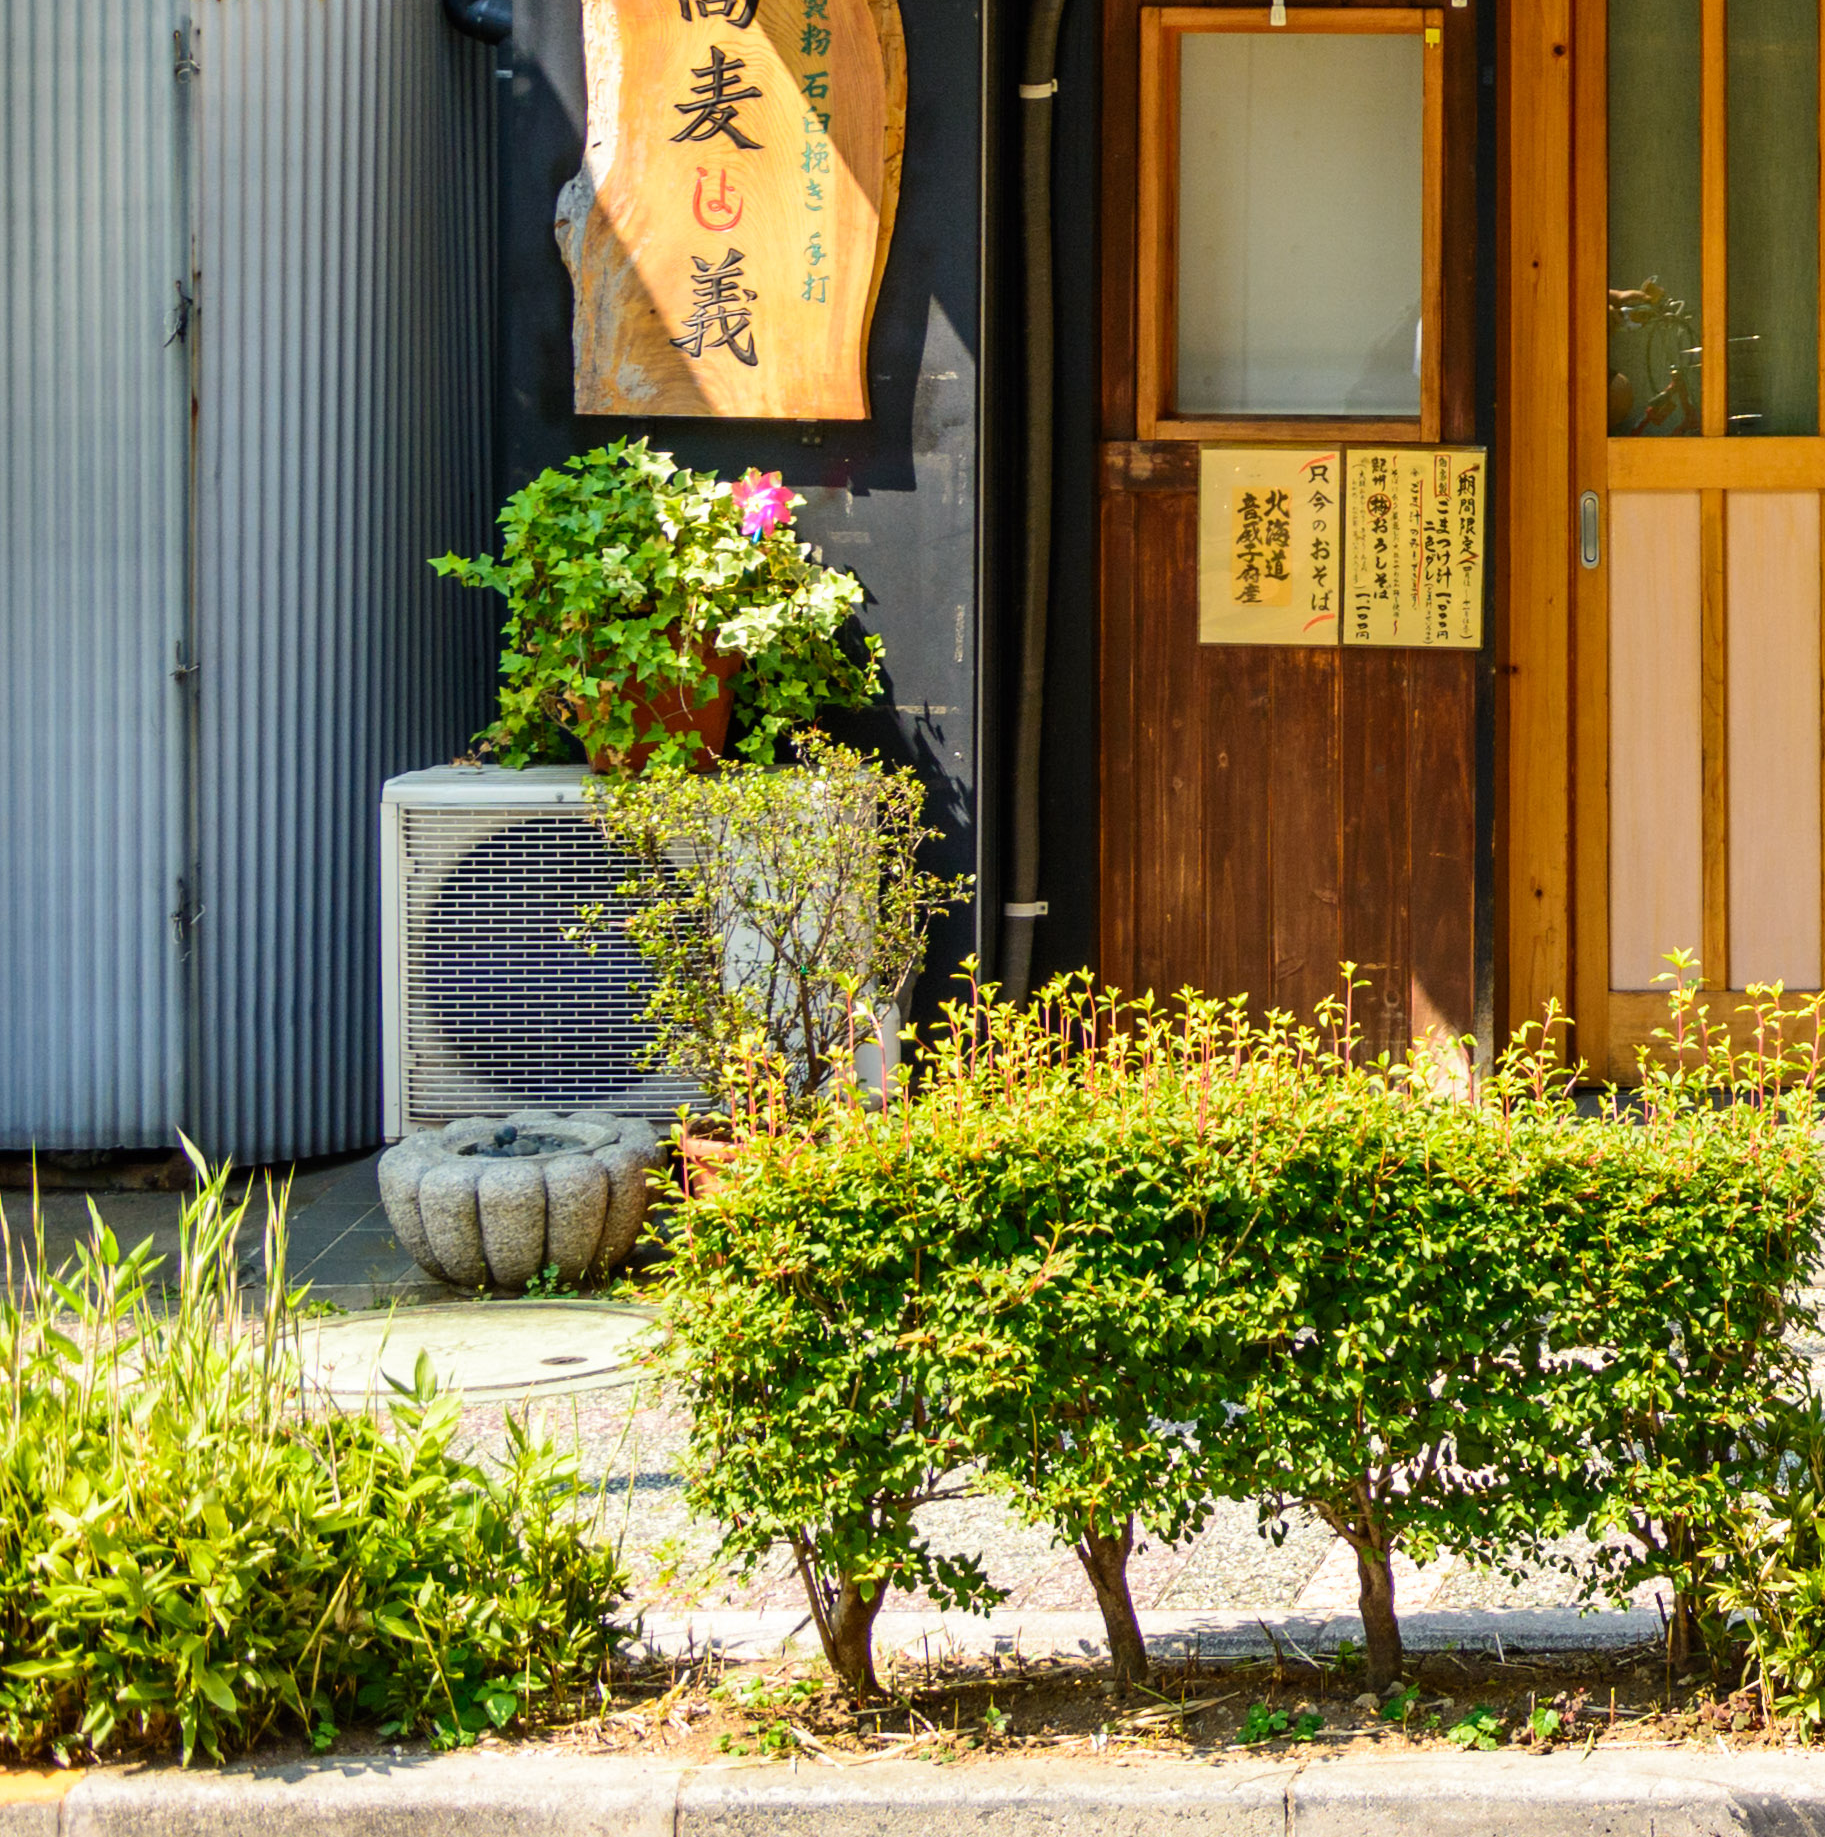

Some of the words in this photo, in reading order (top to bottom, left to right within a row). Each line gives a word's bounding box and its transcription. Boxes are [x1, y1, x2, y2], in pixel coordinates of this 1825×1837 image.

[800, 70, 832, 212] 石臼挽き
[800, 233, 832, 304] 手打
[1235, 491, 1264, 604] 音威子府産
[1264, 489, 1291, 581] 北海道
[1307, 464, 1334, 611] 只今のおそば
[1457, 473, 1477, 556] 期間限定
